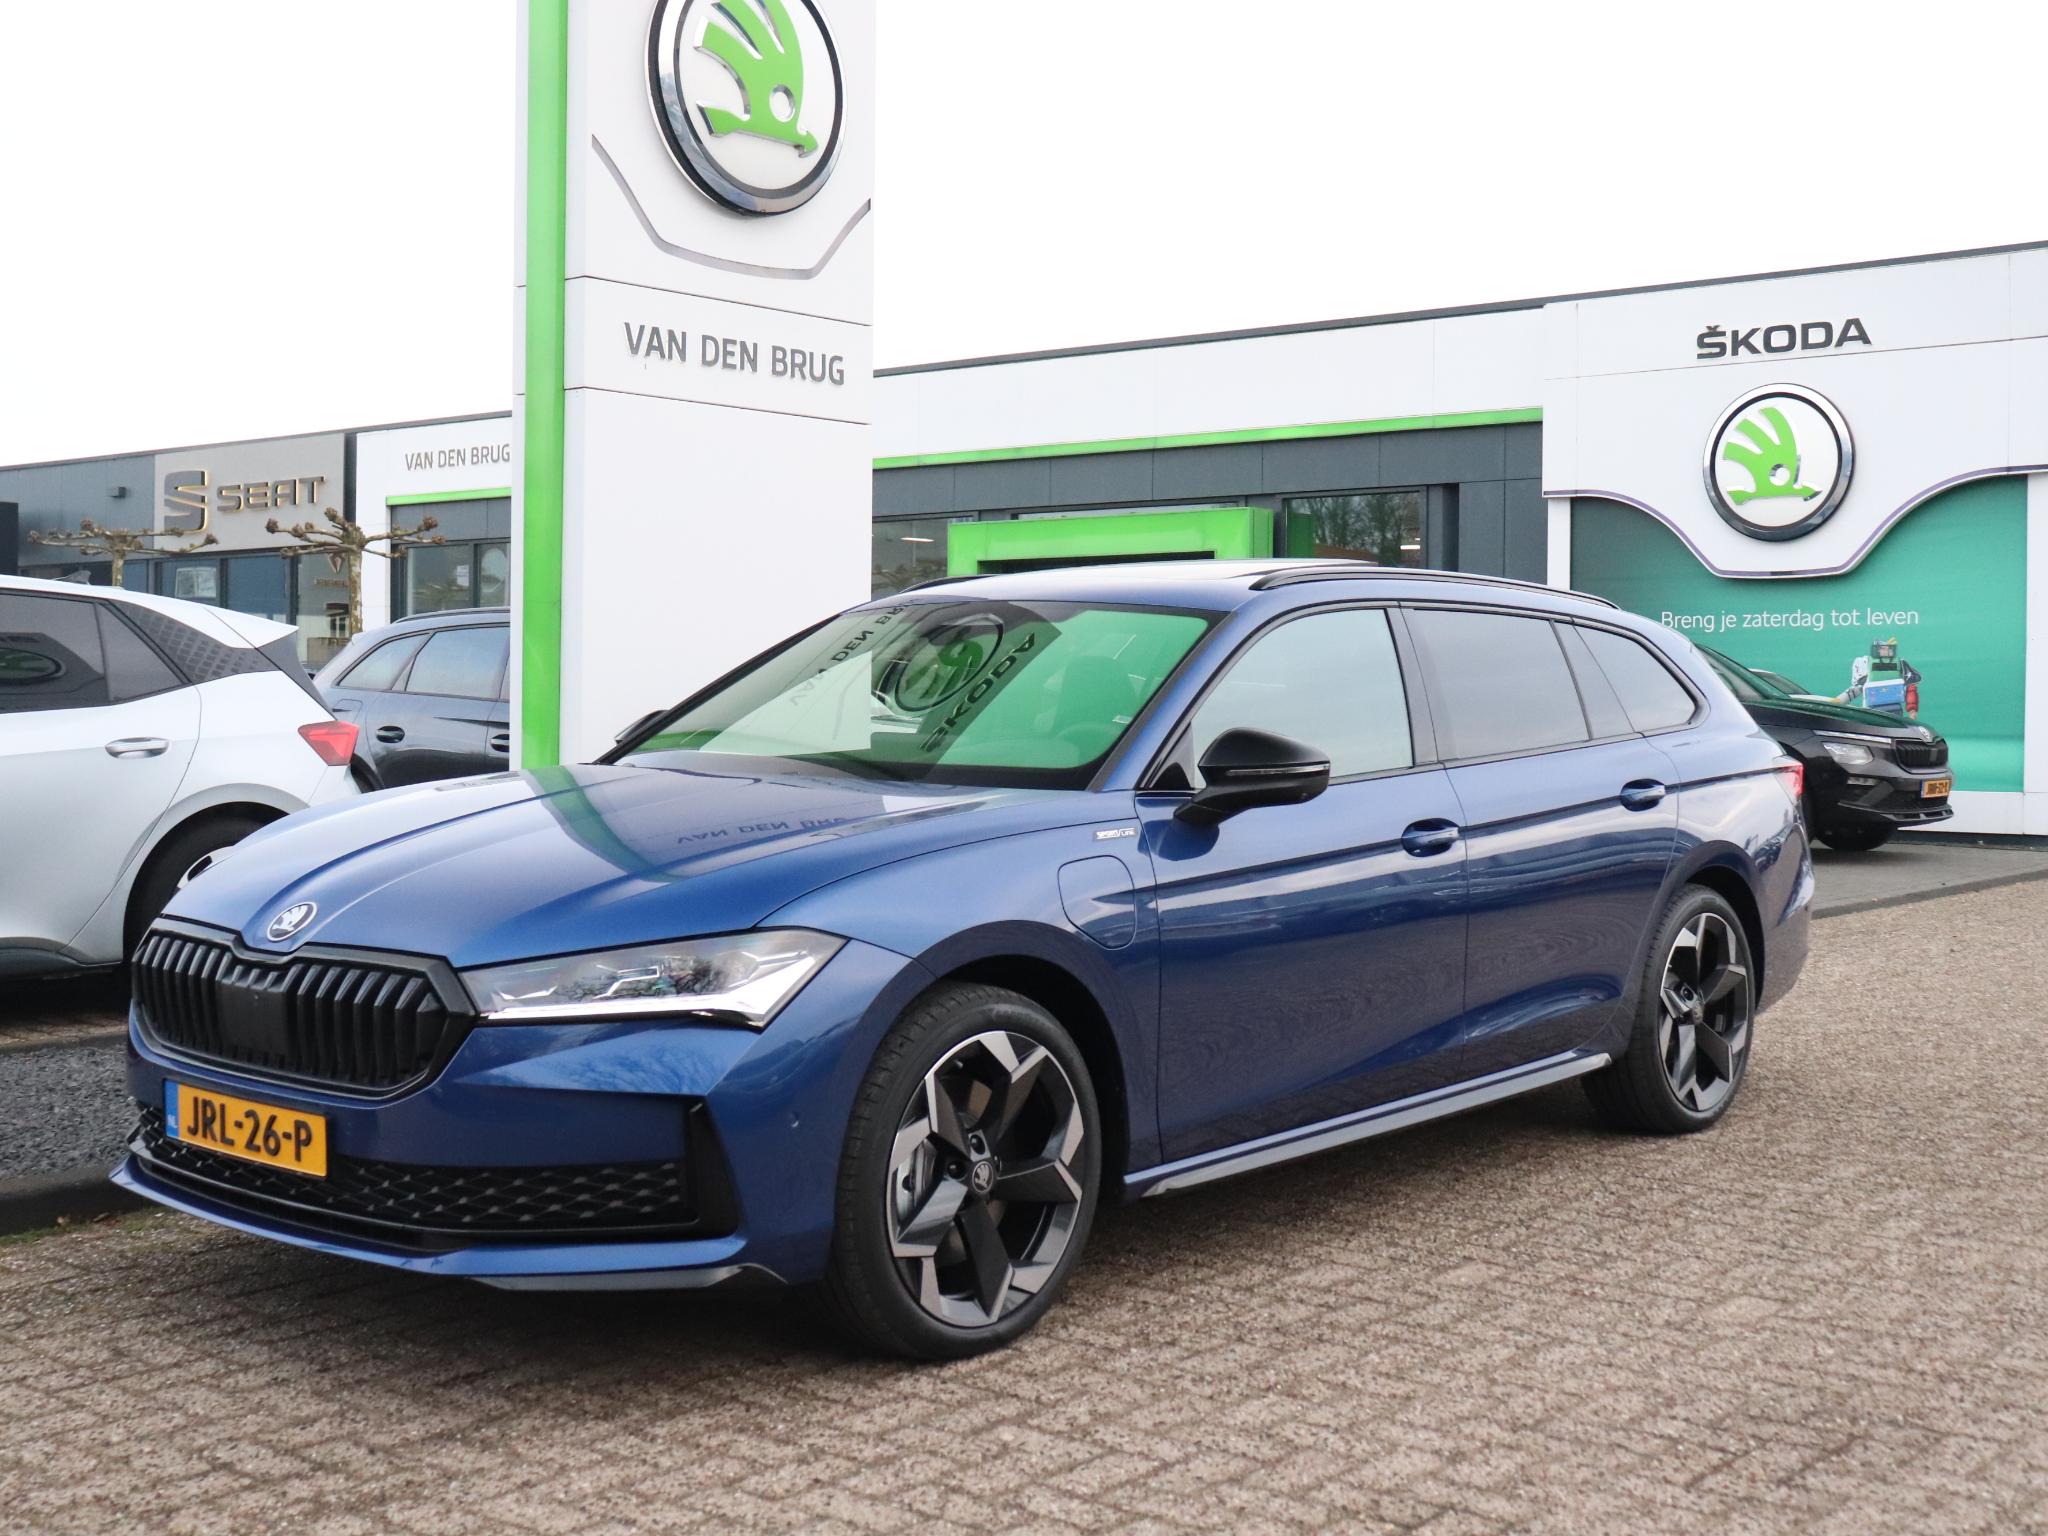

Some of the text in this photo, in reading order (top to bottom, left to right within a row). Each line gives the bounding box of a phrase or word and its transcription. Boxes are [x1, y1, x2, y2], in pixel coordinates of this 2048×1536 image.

[624, 322, 845, 386] VAN DEN BRUG
[1697, 317, 1873, 360] ŠKODA
[405, 443, 511, 471] VAN DEN BRUG
[217, 475, 325, 512] SEAT
[1661, 607, 1919, 632] Breng je zaterdag tot leven
[187, 1096, 313, 1162] JRL-26-P
